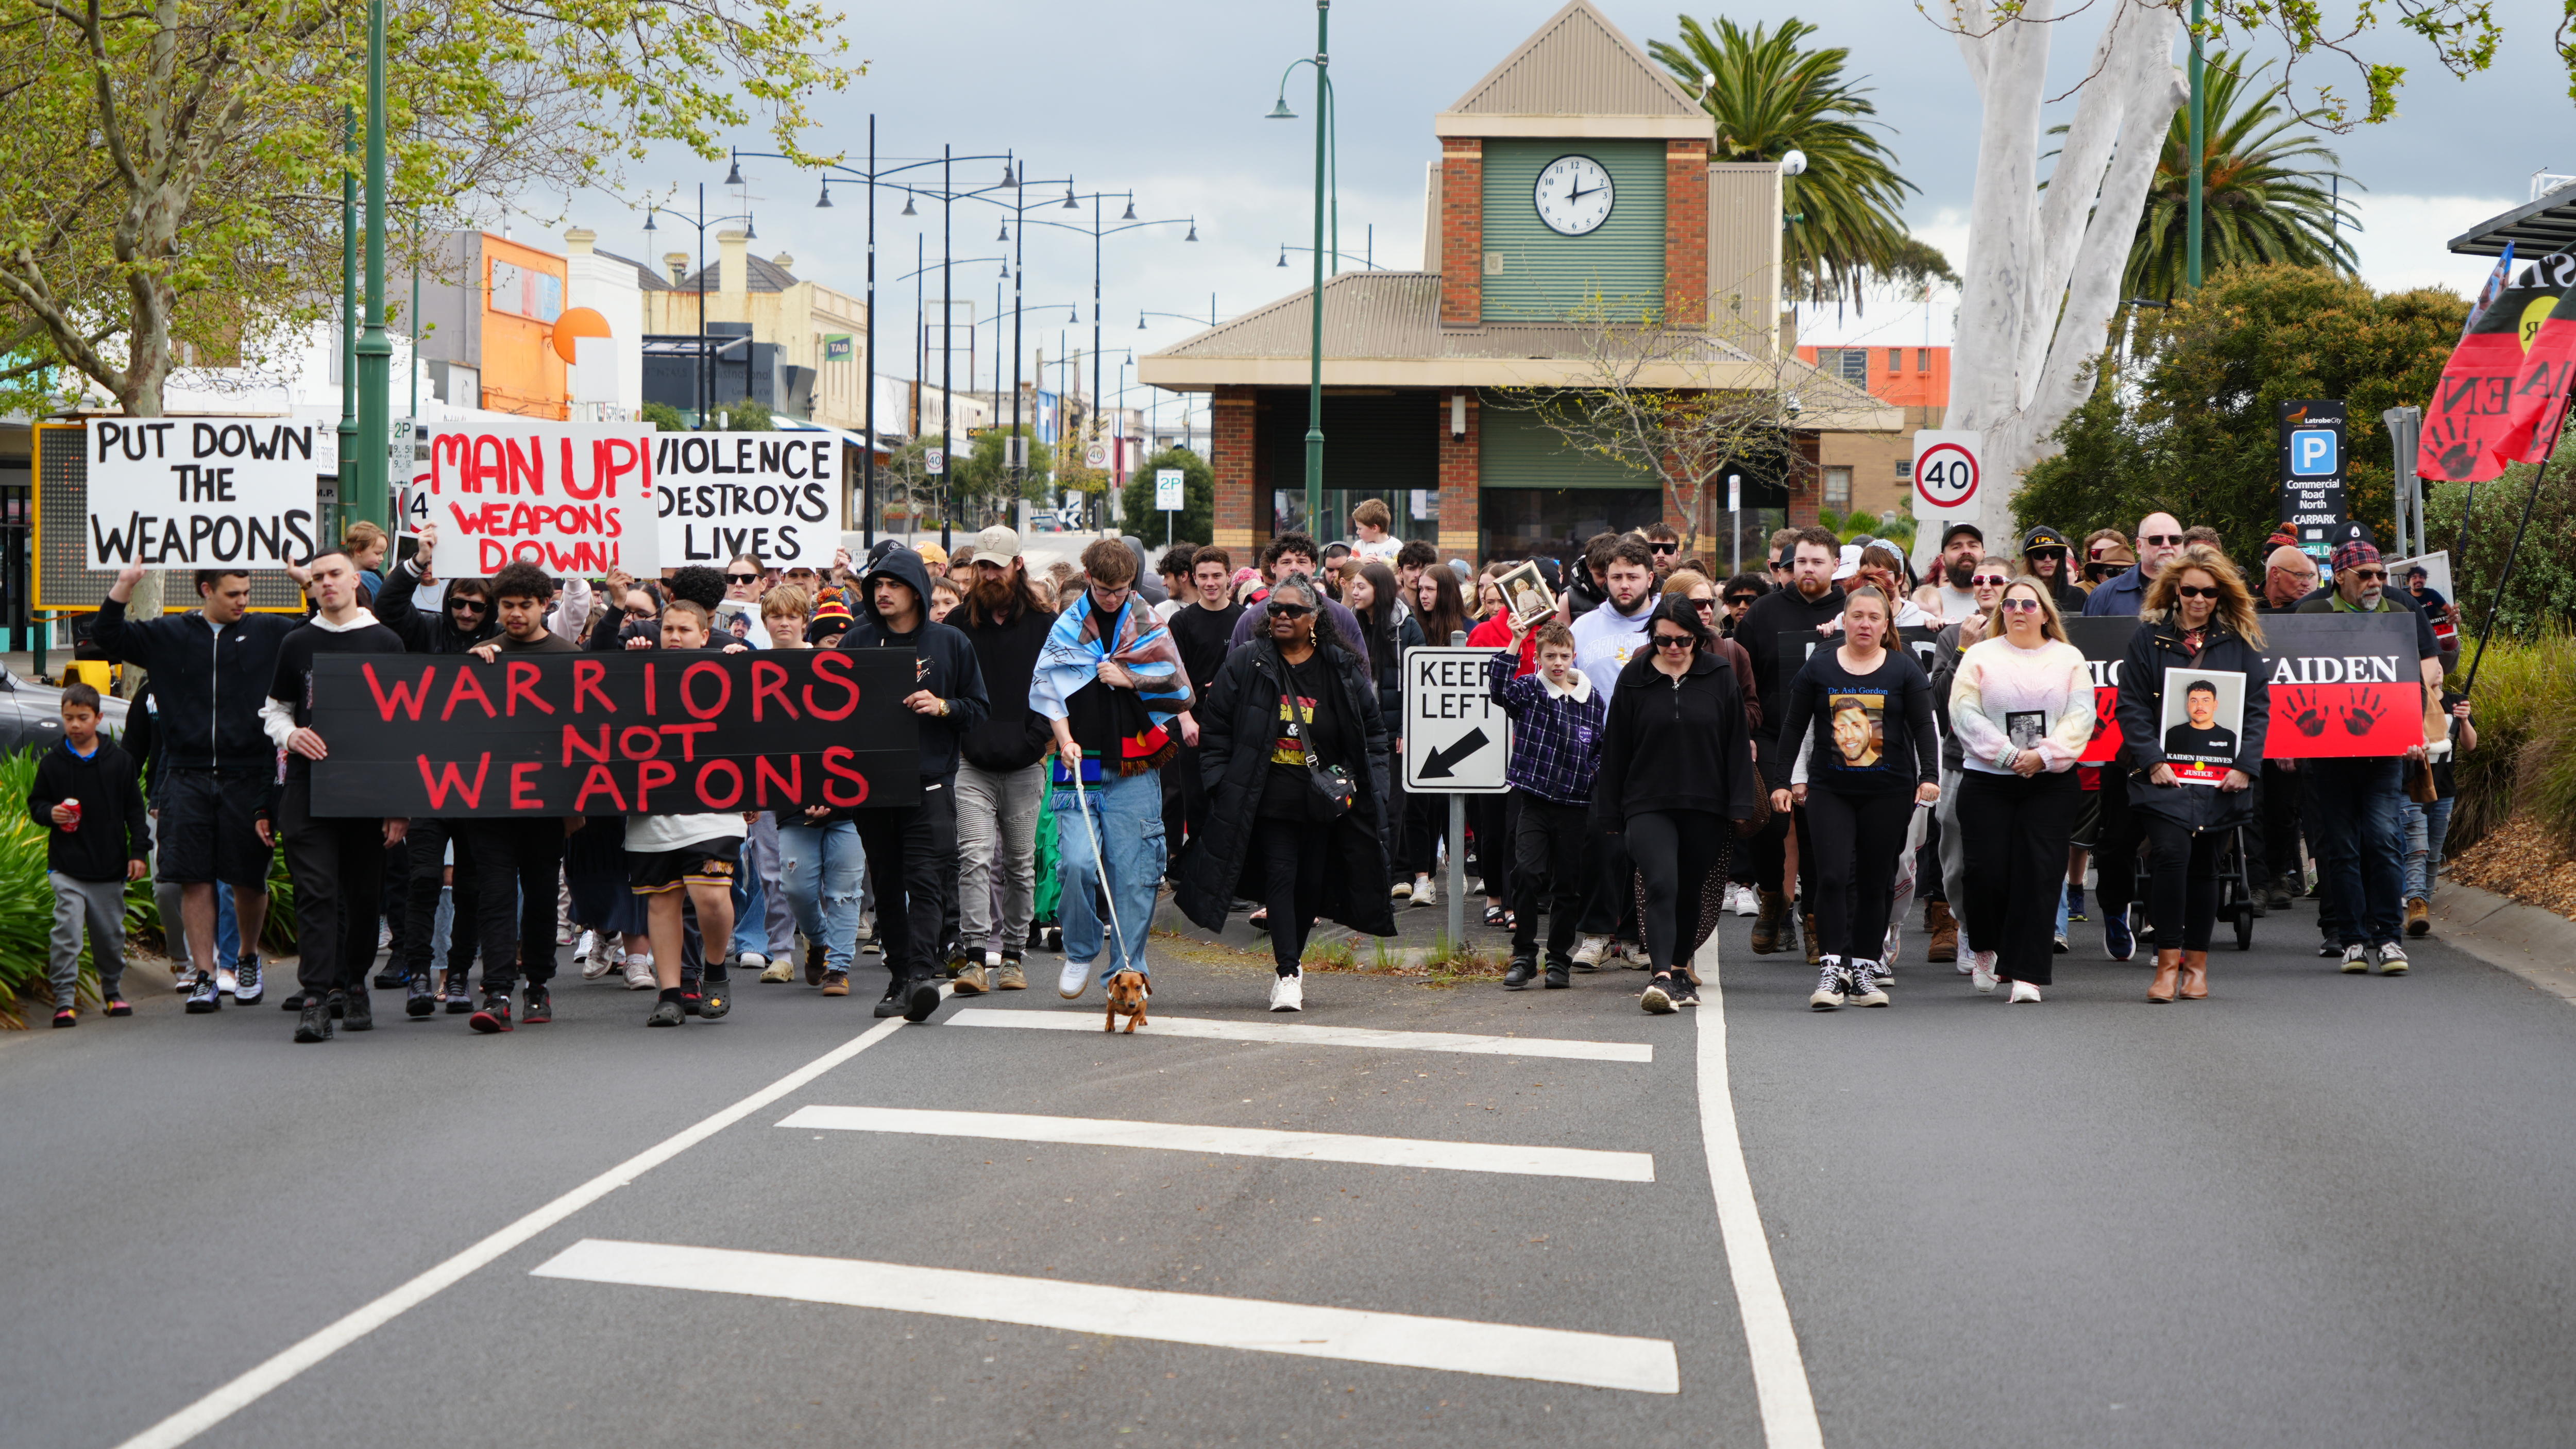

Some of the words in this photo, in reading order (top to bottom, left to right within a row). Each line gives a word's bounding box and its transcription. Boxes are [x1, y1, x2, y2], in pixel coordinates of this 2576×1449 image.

[831, 344, 849, 352] TAB
[98, 422, 175, 463] PUT
[193, 423, 312, 461] DOWN
[395, 422, 411, 438] 2P
[431, 433, 544, 495] MAN
[561, 437, 652, 500] UP!
[929, 456, 941, 465] 40
[2304, 438, 2327, 468] P
[171, 465, 236, 502] THE
[1160, 478, 1181, 490] 2P
[1925, 460, 1969, 489] 40
[2286, 479, 2340, 489] Commercial
[658, 483, 829, 523] DESTROYS
[2300, 500, 2327, 509] North
[2301, 490, 2325, 499] Road
[448, 501, 622, 538] WEAPONS
[2293, 514, 2336, 524] CARPARK
[91, 509, 314, 566] WEAPONS
[685, 523, 801, 561] LIVES
[480, 540, 619, 574] DOWN!
[2262, 656, 2399, 684] AIDEN
[362, 651, 860, 722] WARRIORS
[1422, 693, 1490, 719] LEFT
[562, 722, 717, 768] NOT
[2195, 755, 2233, 764] DESERVES
[416, 745, 869, 812] WEAPONS
